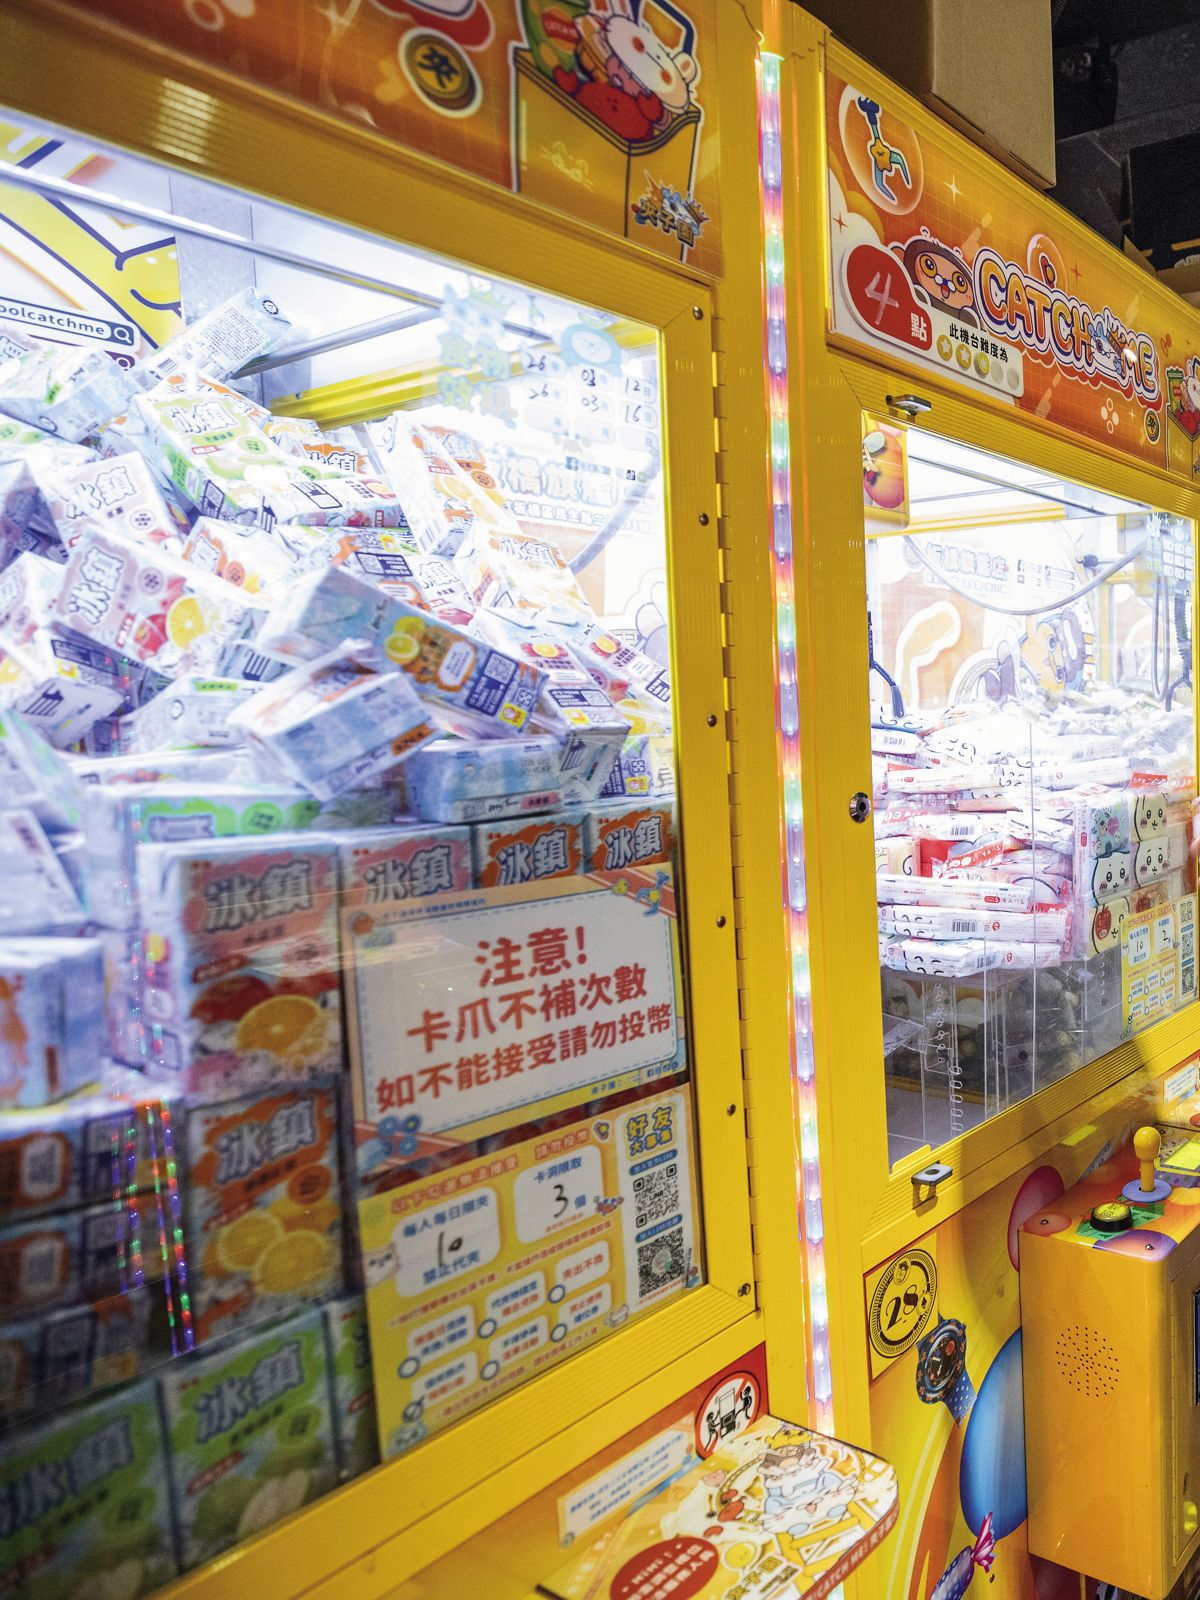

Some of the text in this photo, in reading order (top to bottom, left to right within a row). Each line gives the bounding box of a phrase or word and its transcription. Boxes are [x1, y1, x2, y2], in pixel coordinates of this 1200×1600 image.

[864, 271, 927, 342] 4 點
[978, 257, 1096, 364] CATCH
[949, 322, 1008, 363] 此機台難度為
[625, 377, 641, 394] 12
[624, 404, 641, 423] 16
[497, 829, 569, 886] 冰鎮
[604, 815, 662, 870] 冰鎮
[474, 925, 587, 988] 注意!
[406, 962, 647, 1054] 卡爪不補次數
[375, 1002, 673, 1114] 如不能接受請勿投幣
[626, 1105, 673, 1141] 好友
[553, 1184, 568, 1218] 3
[885, 1283, 919, 1331] 28
